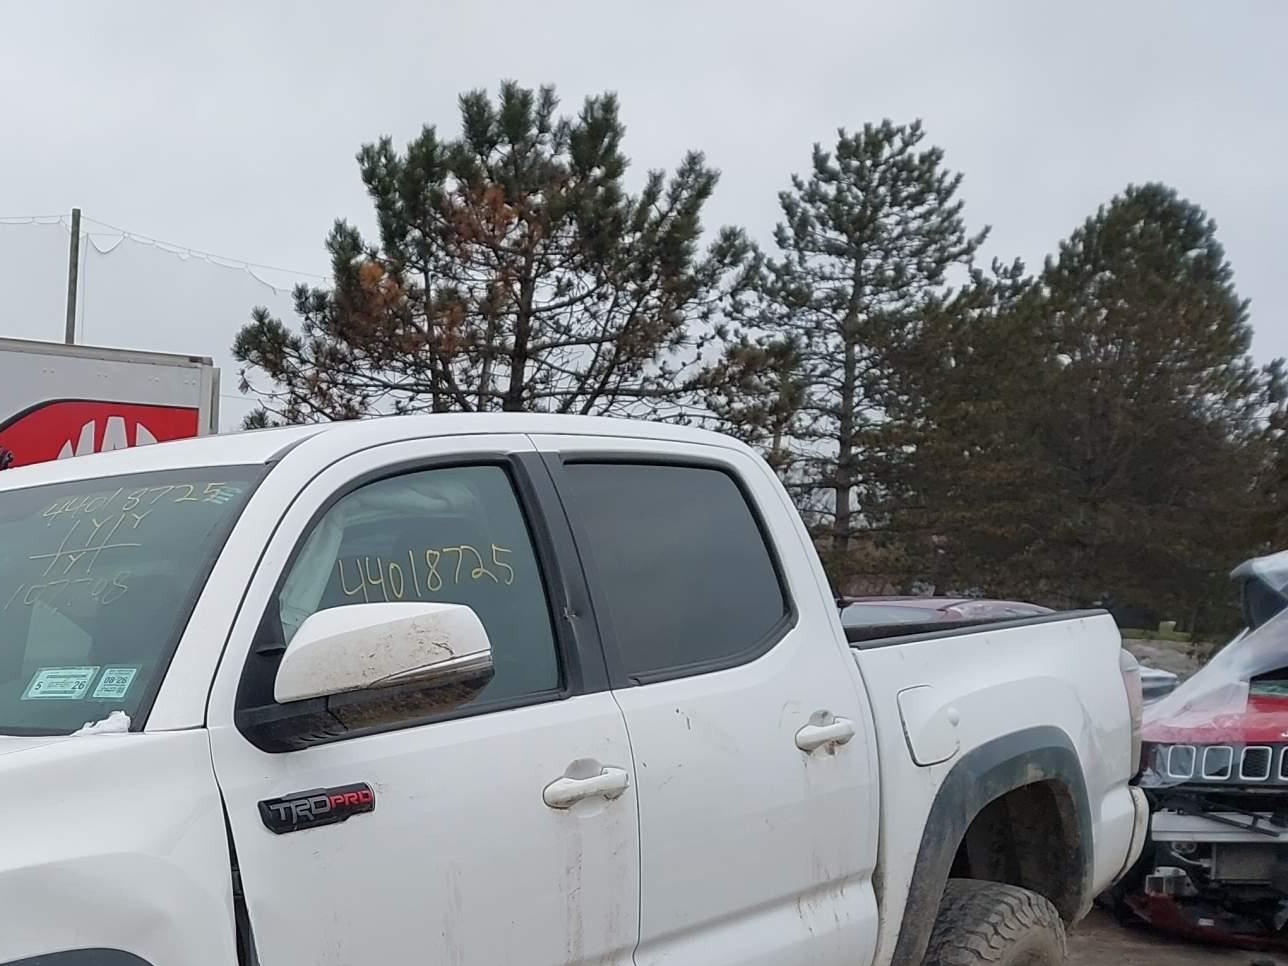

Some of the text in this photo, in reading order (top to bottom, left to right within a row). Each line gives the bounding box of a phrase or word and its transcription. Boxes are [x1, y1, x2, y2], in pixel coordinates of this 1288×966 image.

[339, 543, 514, 603] 44018725
[72, 681, 87, 690] 26
[269, 790, 373, 824] TRD PRO
